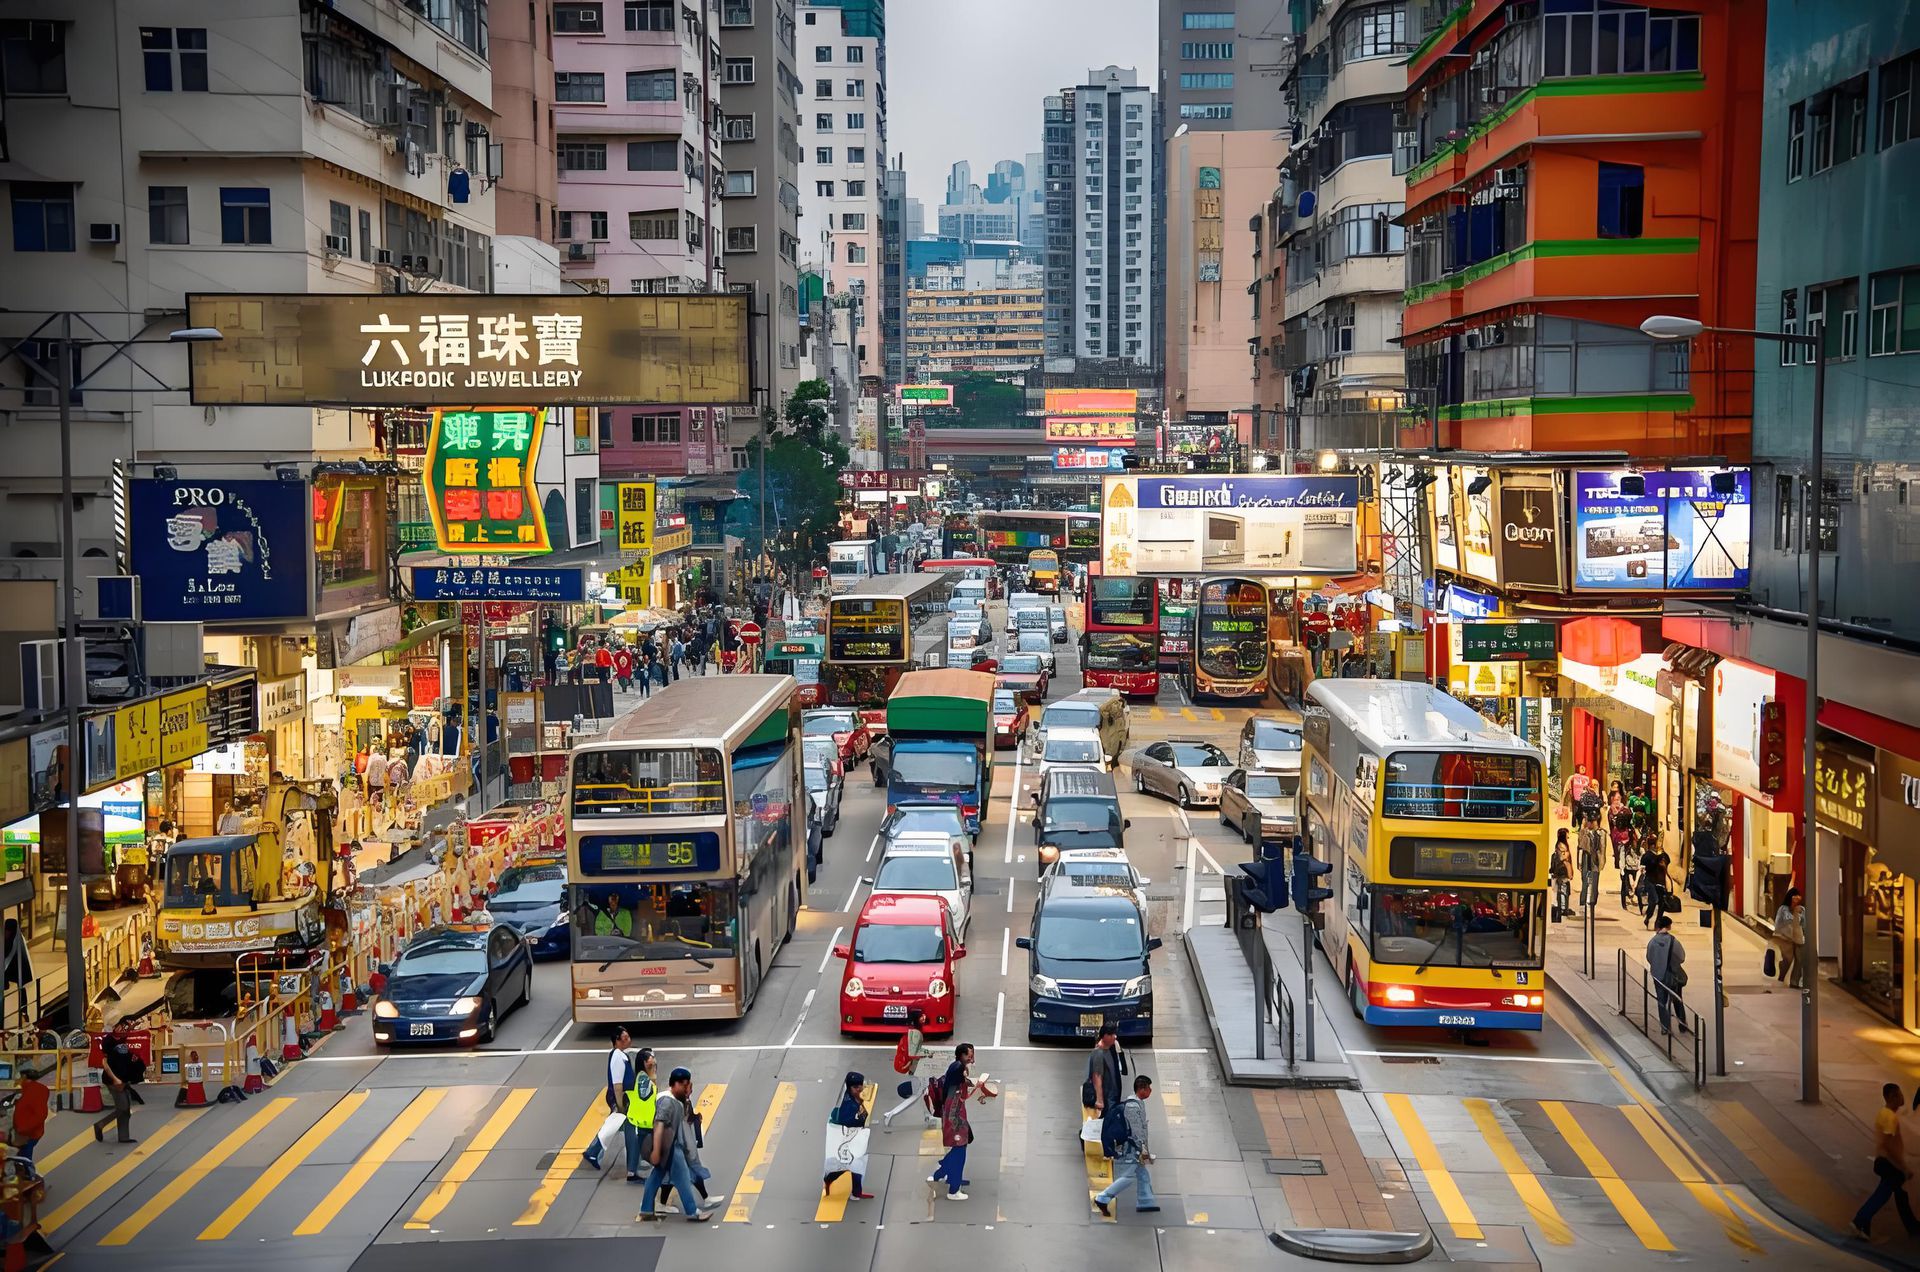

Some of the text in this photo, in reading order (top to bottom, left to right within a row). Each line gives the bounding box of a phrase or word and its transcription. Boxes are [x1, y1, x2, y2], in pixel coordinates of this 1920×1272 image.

[360, 312, 583, 367] 六福珠寶
[464, 370, 583, 388] JEWELLERY
